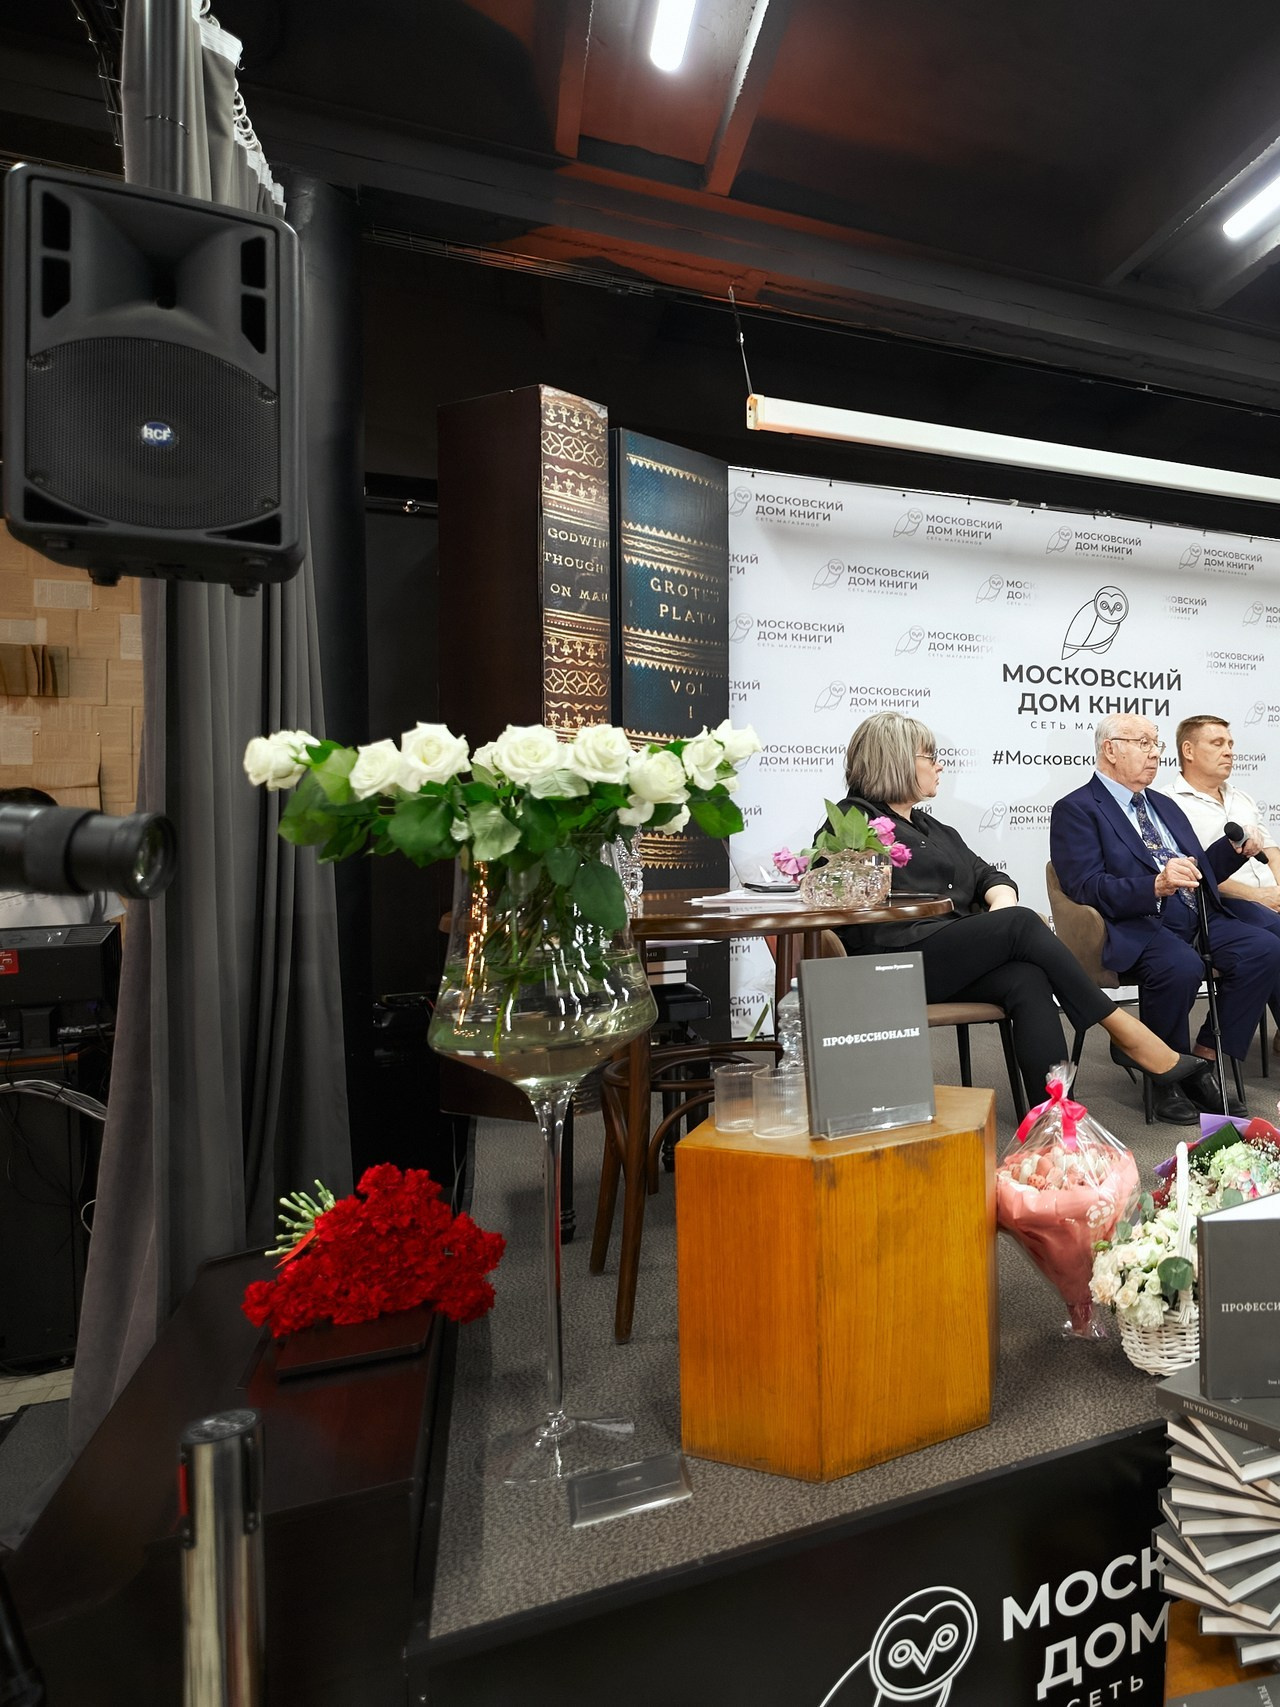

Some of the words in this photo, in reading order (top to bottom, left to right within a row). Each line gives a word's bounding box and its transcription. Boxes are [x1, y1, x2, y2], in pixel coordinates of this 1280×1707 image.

[143, 425, 173, 441] RCF
[755, 493, 844, 511] МОСКОВСКИЙ
[755, 505, 786, 517] ДОМ
[790, 509, 831, 522] КНИГИ
[926, 514, 1003, 530] МОСКОВСКИЙ
[926, 525, 952, 536] ДОМ
[955, 528, 992, 540] КНИГИ
[1075, 531, 1142, 546] МОСКОВСКИЙ
[1076, 542, 1098, 552] ДОМ
[1101, 544, 1133, 556] КНИГИ
[1204, 548, 1263, 562] МОСКОВСКИЙ
[847, 564, 930, 580] МОСКОВСКИЙ
[1204, 558, 1225, 567] ДОМ
[1226, 560, 1255, 571] КНИГИ
[550, 583, 572, 598] ON
[848, 576, 876, 587] ДОМ
[880, 579, 918, 590] КНИГИ
[757, 618, 845, 633] МОСКОВСКИЙ
[758, 630, 788, 642] ДОМ
[791, 633, 832, 644] КНИГИ
[928, 642, 954, 652] ДОМ
[1002, 663, 1182, 692] МОСКОВСКИЙ
[849, 686, 931, 698] МОСКОВСКИЙ
[850, 697, 878, 708] ДОМ
[880, 698, 920, 708] КНИГИ
[1018, 692, 1080, 715] ДОМ
[1089, 694, 1170, 717] КНИГИ
[1030, 720, 1067, 730] СЕТЬ
[761, 744, 846, 755] МОСКОВСКИЙ
[759, 756, 789, 766] ДОМ
[793, 757, 834, 766] КНИГИ
[1009, 805, 1052, 814] МОСКОВ
[1010, 815, 1034, 825] ДОМ
[822, 1026, 920, 1047] ПРОФЕССИОНАЛЫ
[1182, 1400, 1249, 1432] ПРОФЕССИОНАЛЫ
[1037, 1602, 1172, 1700] ДОМ
